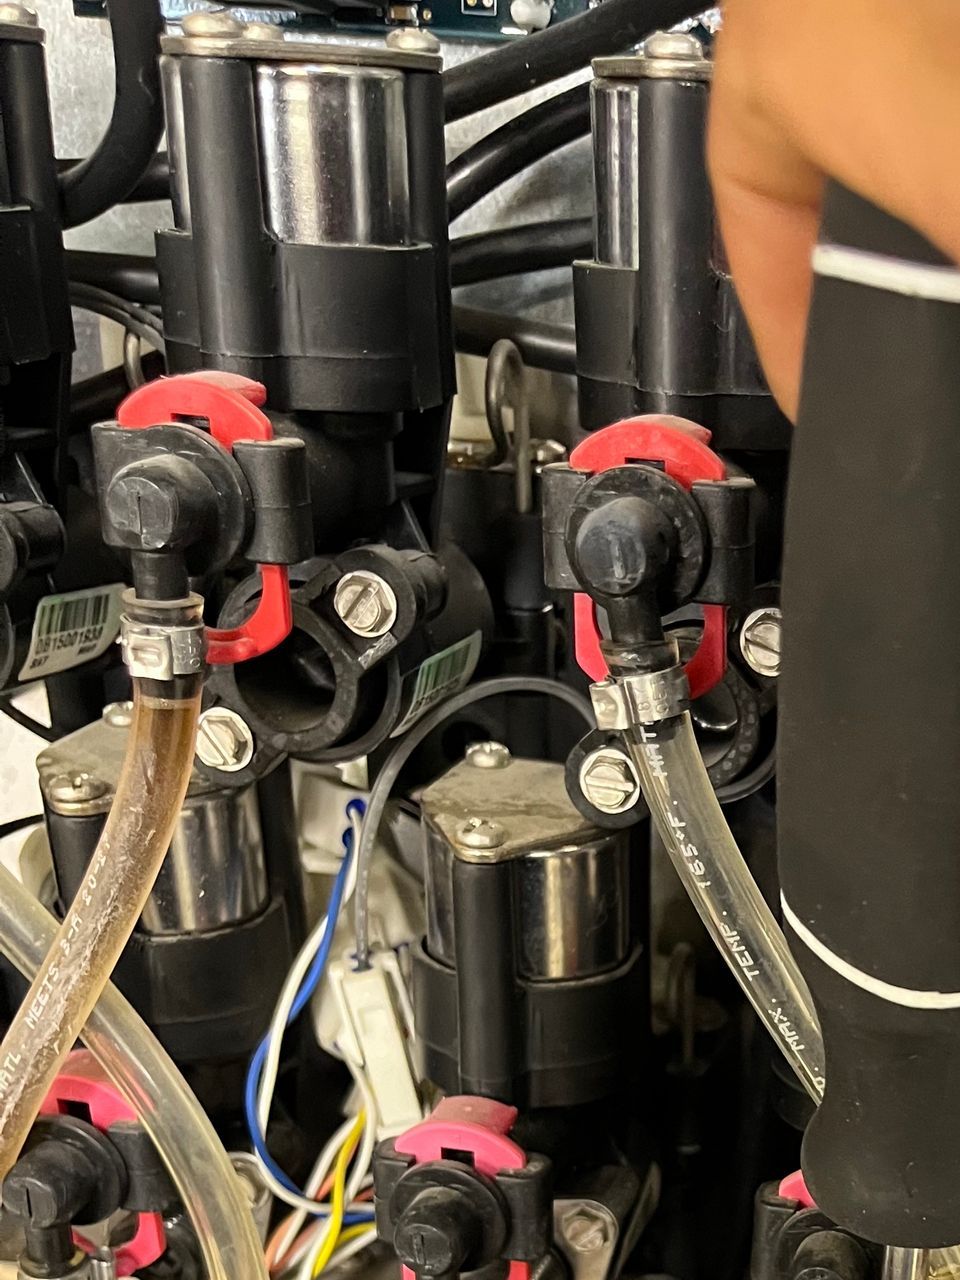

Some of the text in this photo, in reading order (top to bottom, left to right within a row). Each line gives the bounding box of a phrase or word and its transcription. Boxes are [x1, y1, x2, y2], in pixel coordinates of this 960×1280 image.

[719, 910, 760, 981] TEMP.
[23, 960, 61, 1030] MEETS
[767, 998, 805, 1051] MAX.
